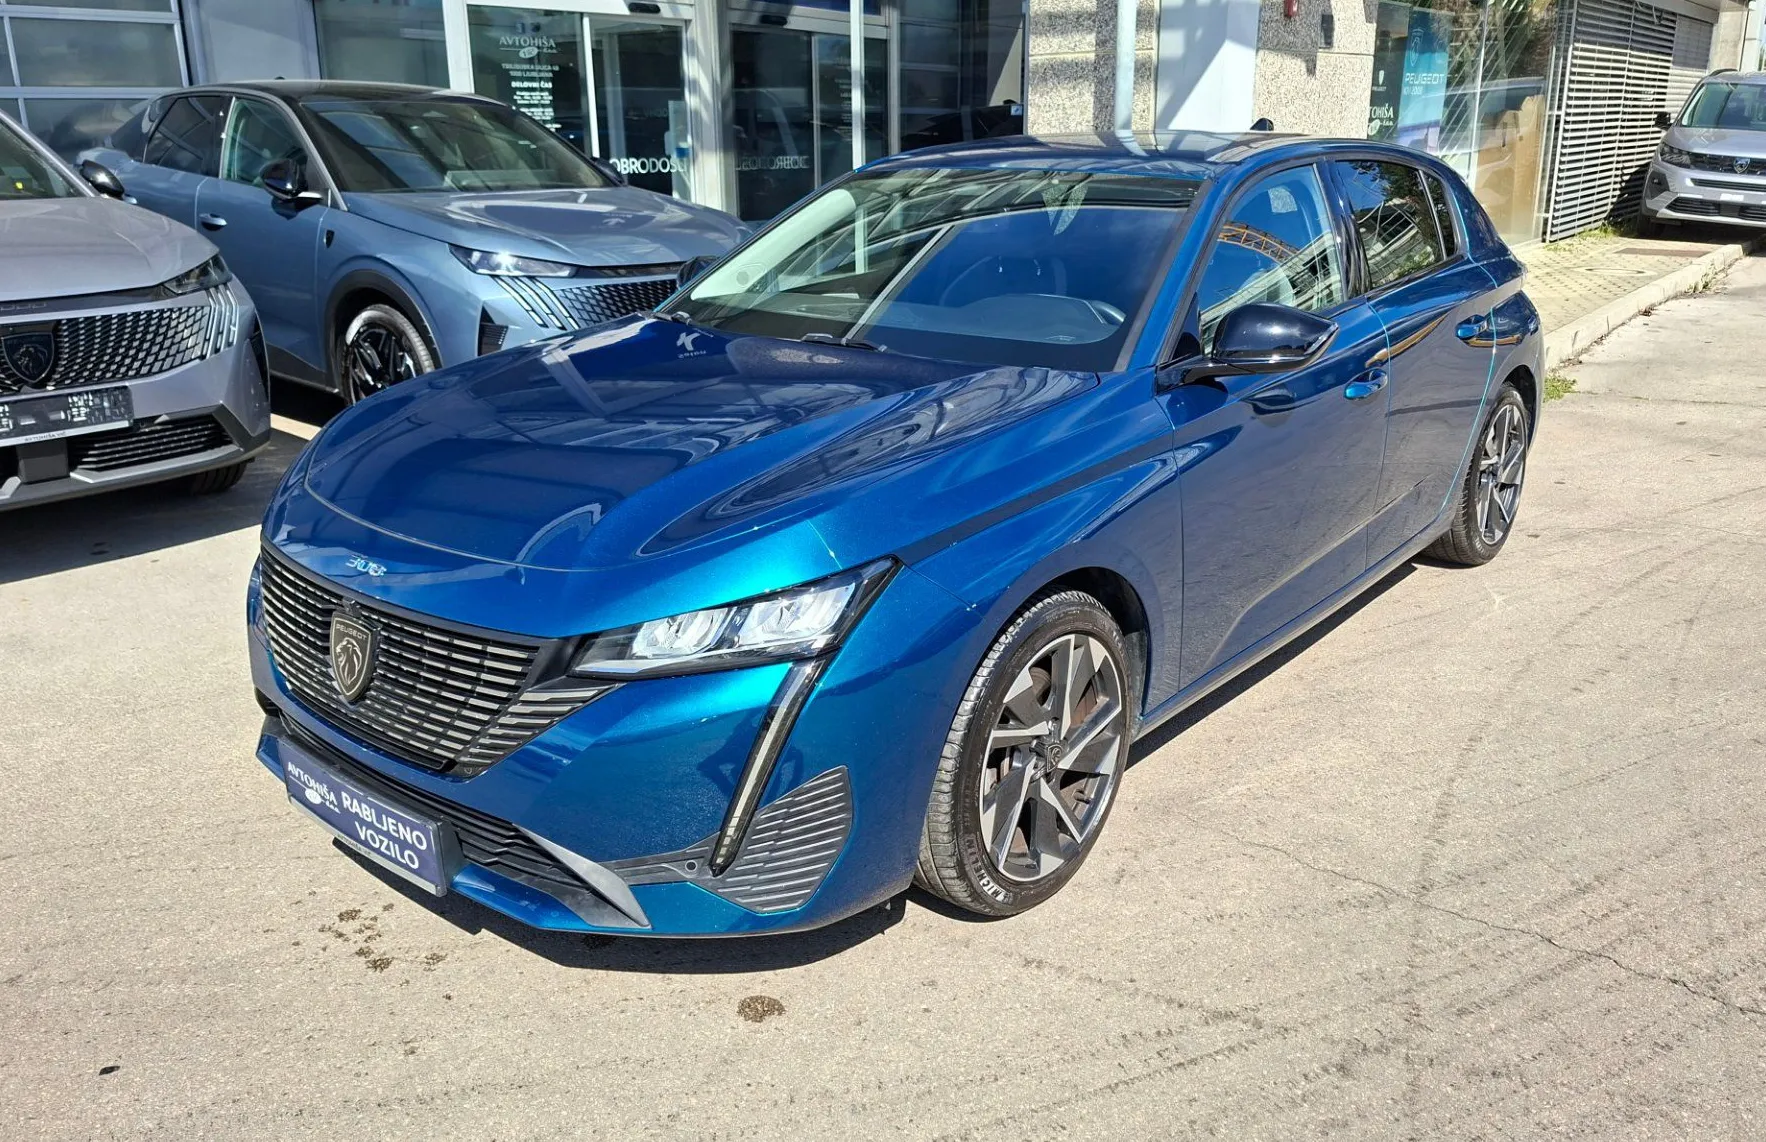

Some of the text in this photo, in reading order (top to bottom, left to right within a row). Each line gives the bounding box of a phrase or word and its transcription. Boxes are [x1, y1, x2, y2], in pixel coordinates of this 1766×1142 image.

[499, 35, 556, 48] AVTOHIŠA
[1404, 72, 1445, 84] PEUGEOT
[335, 623, 367, 641] PEUGEOT
[287, 761, 339, 806] AVTOHIŠA
[341, 791, 428, 851] RABLJENO
[355, 821, 420, 870] VOZILO
[965, 837, 1003, 900] MICHELIN
